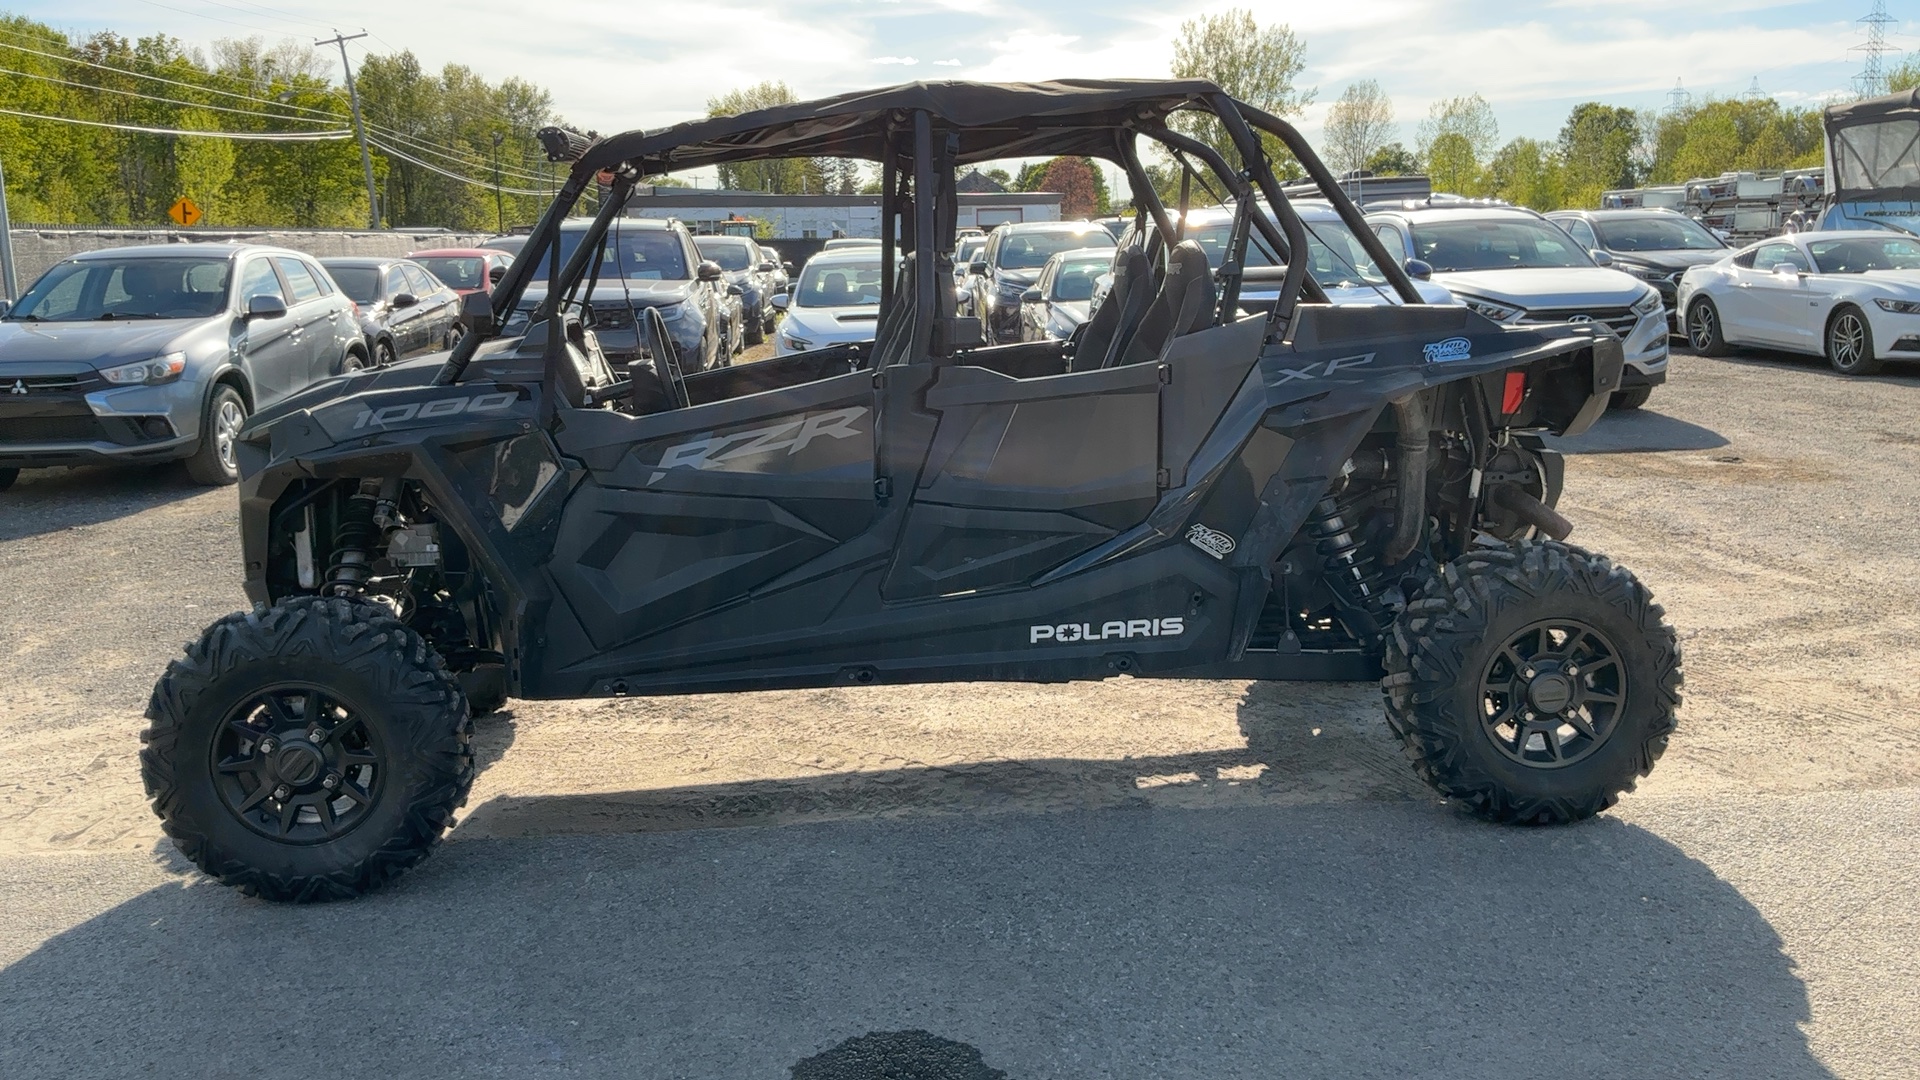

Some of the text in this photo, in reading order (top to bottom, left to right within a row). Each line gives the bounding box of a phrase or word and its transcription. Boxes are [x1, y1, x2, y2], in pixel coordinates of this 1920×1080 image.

[1268, 352, 1376, 387] XP
[353, 391, 519, 429] 1000
[646, 406, 869, 486] RZR
[1030, 617, 1184, 643] POLARIS
